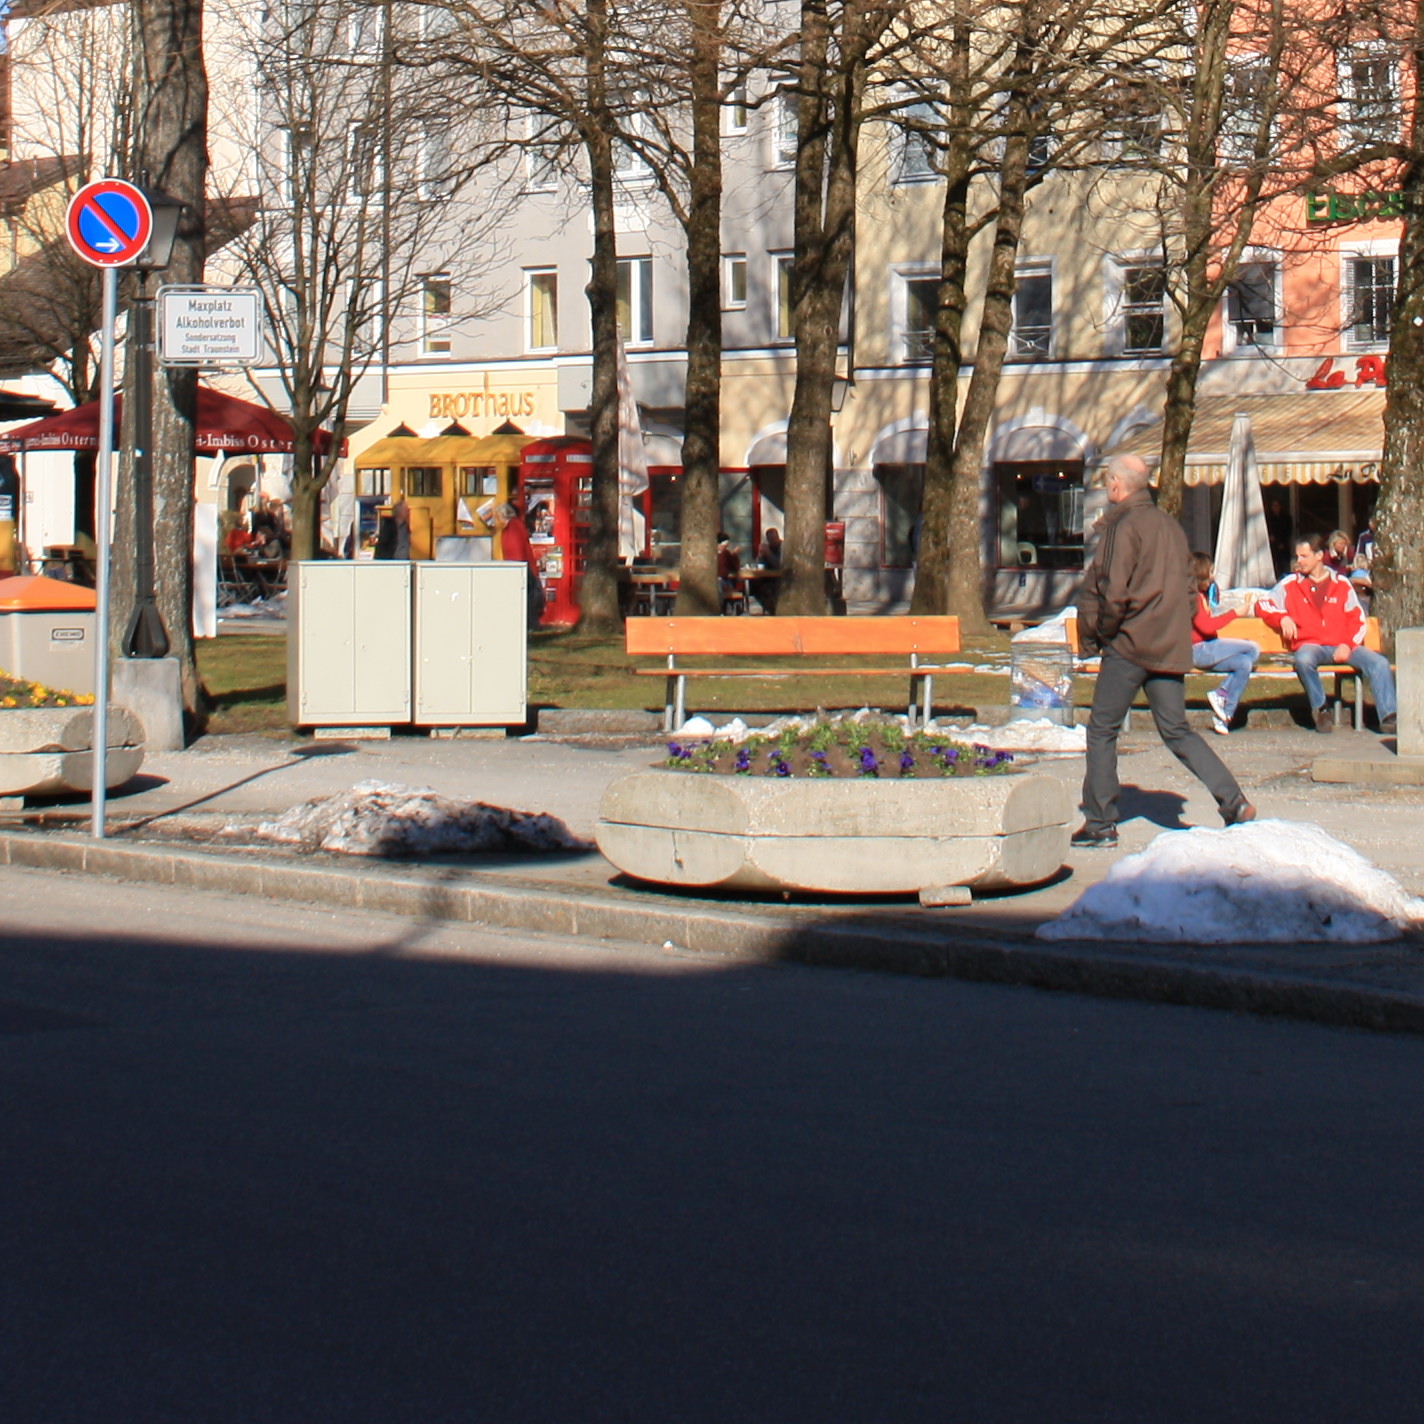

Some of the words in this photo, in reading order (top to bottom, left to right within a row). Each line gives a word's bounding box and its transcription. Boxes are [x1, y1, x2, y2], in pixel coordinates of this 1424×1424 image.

[188, 300, 233, 315] Maxplatz
[176, 316, 246, 329] Alkoholverbot
[185, 333, 236, 343] Sondersatzung
[181, 344, 200, 353] Stadt
[203, 344, 240, 353] Traunstein
